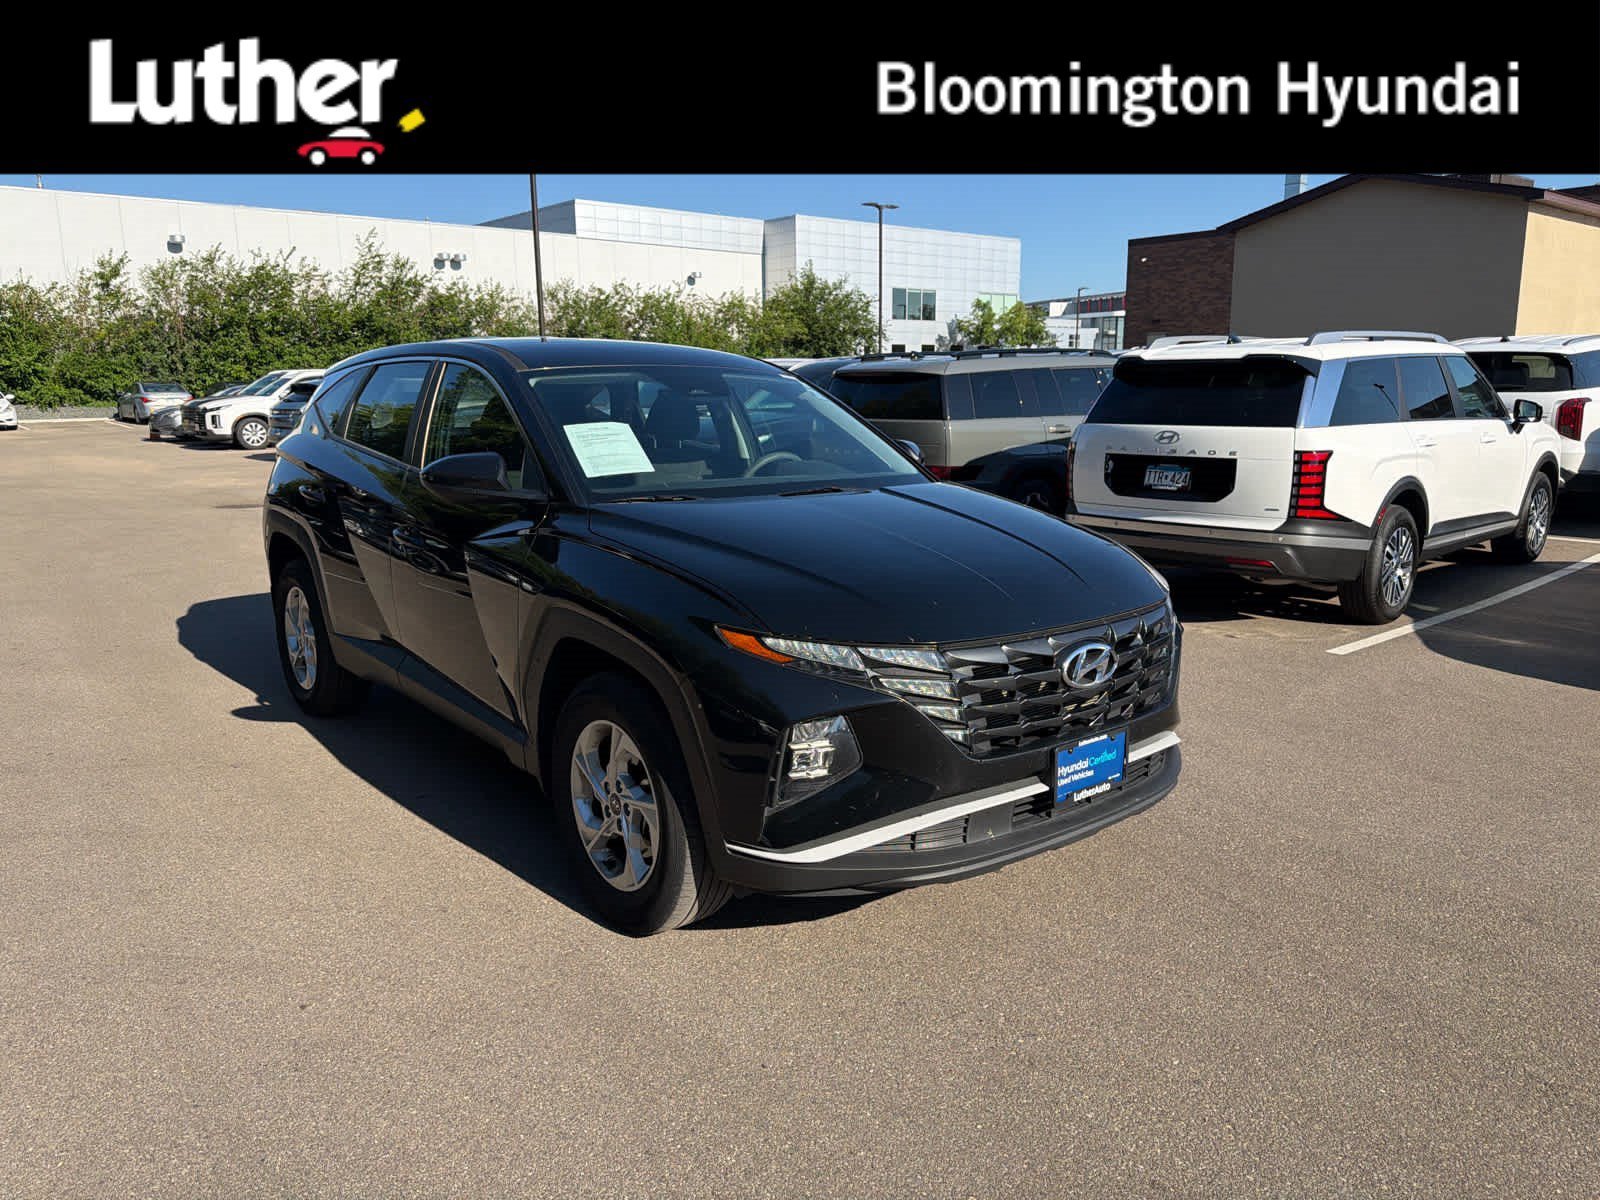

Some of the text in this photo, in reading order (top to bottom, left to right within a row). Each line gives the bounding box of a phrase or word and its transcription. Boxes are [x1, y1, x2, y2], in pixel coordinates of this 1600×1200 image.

[1105, 445, 1238, 457] PALISADE
[1058, 748, 1117, 777] Hyundai Certified
[1058, 776, 1071, 786] Used
[1073, 782, 1111, 801] LutherAuto
